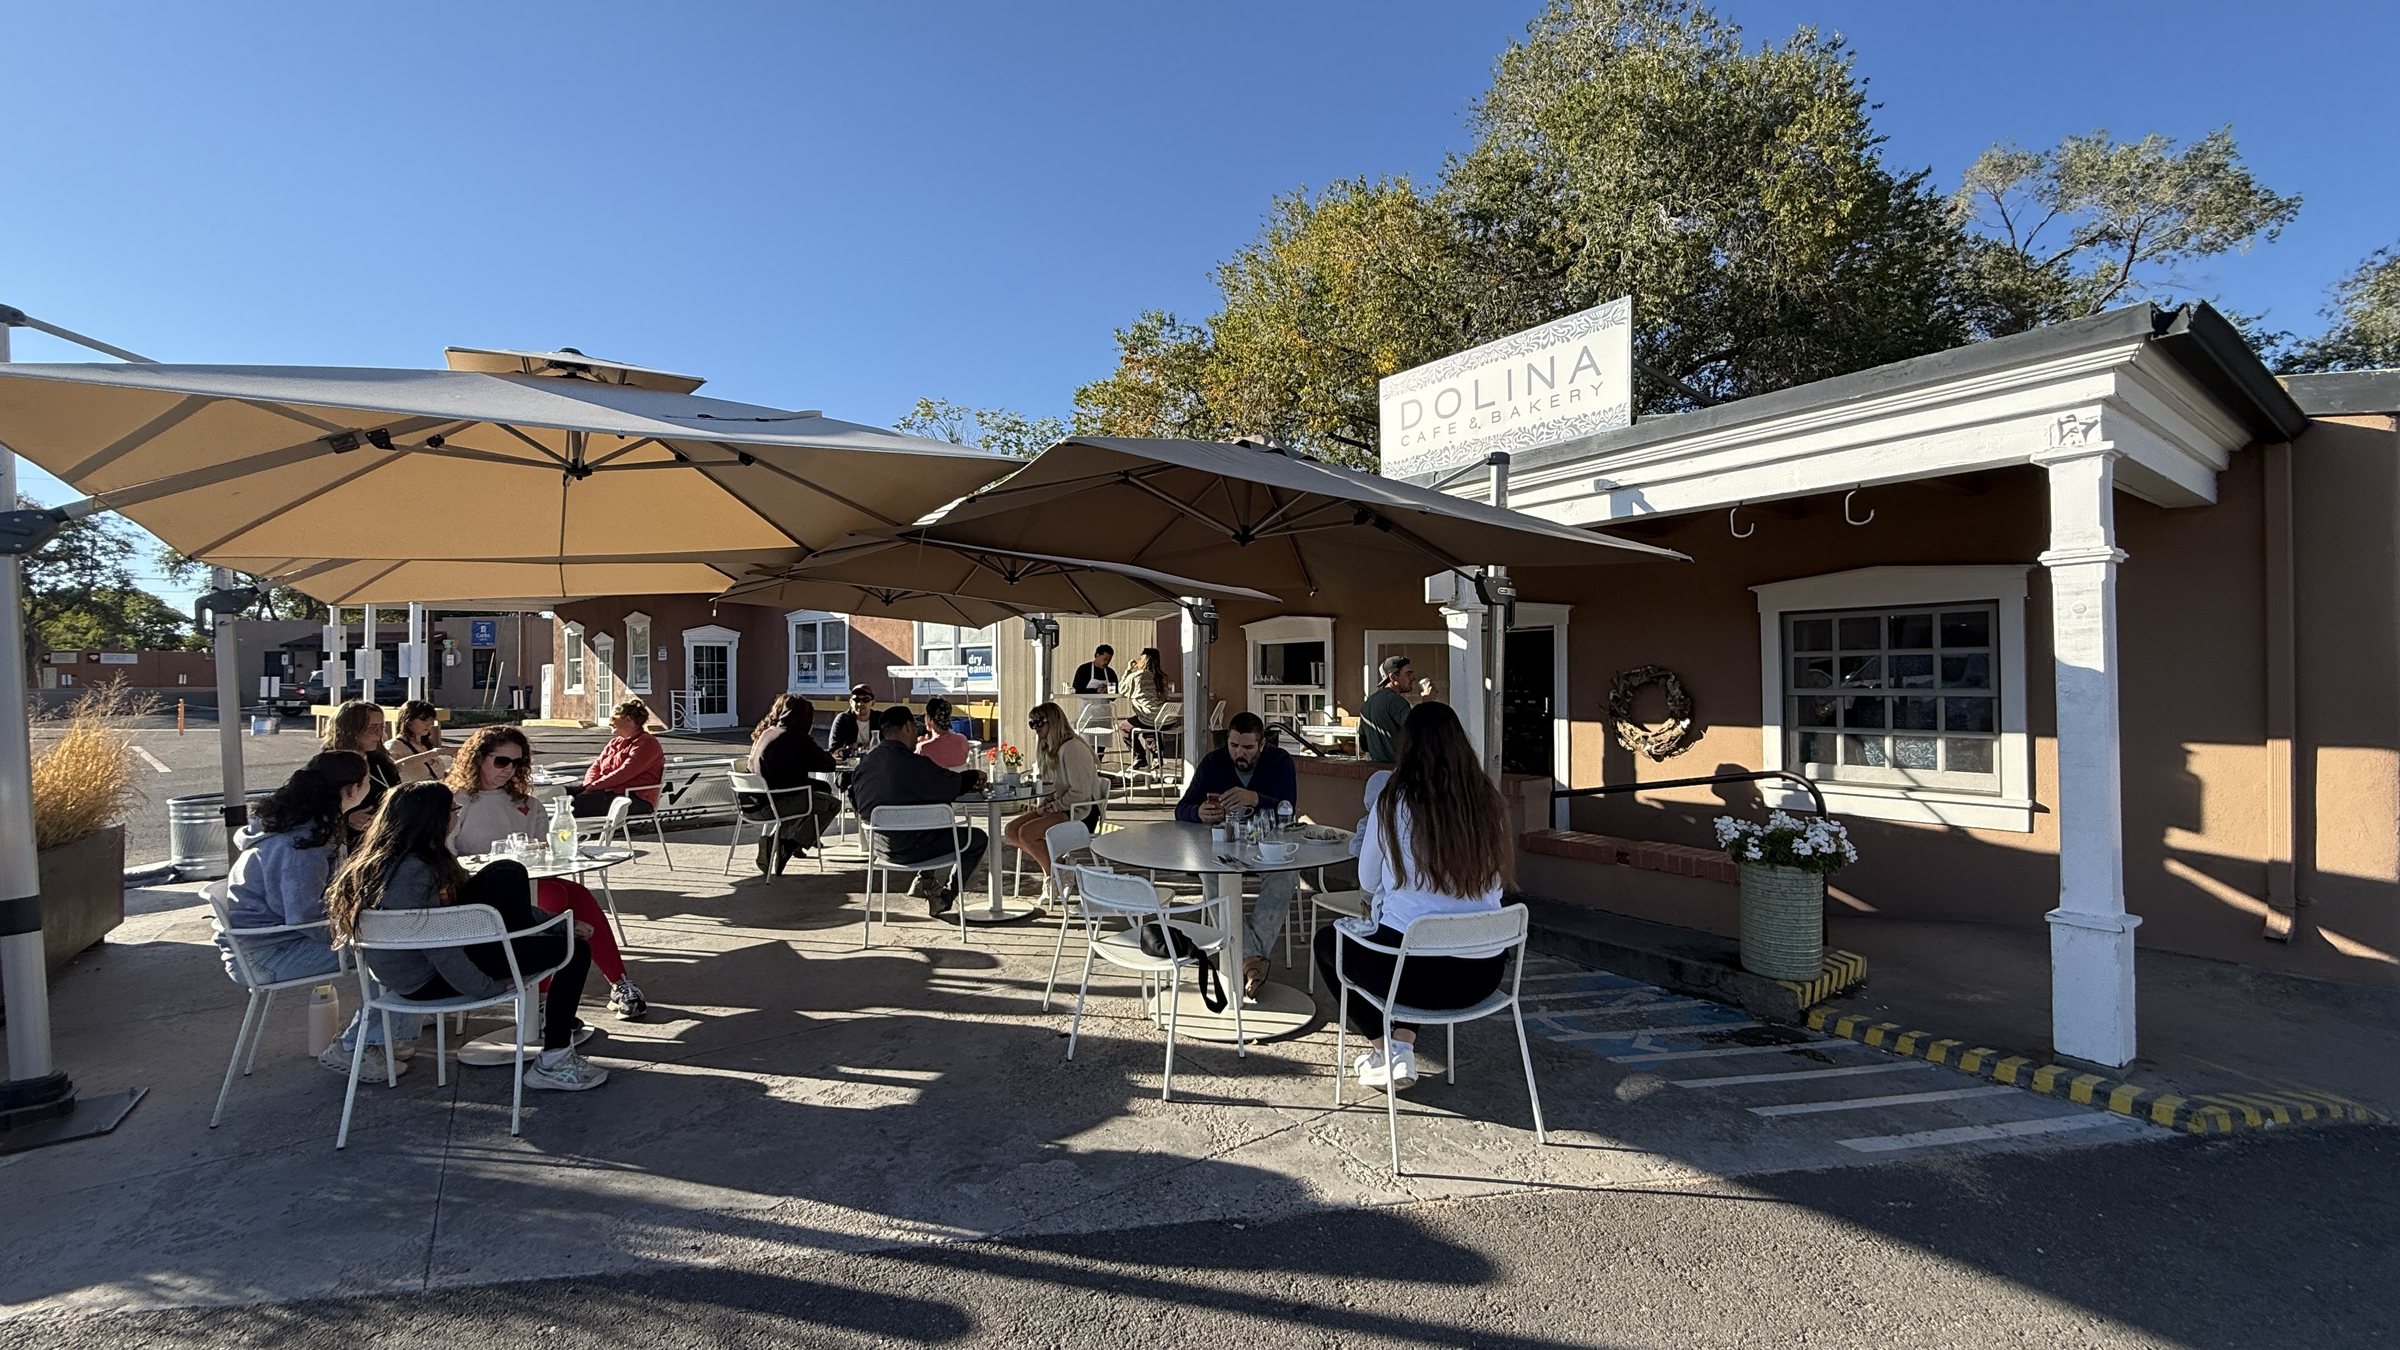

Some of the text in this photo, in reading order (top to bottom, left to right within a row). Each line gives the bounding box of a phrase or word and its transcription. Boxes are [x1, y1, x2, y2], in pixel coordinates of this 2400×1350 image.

[1401, 345, 1602, 431] DOLINA
[1401, 381, 1604, 447] CAFE & BAKERY
[968, 654, 983, 666] dry
